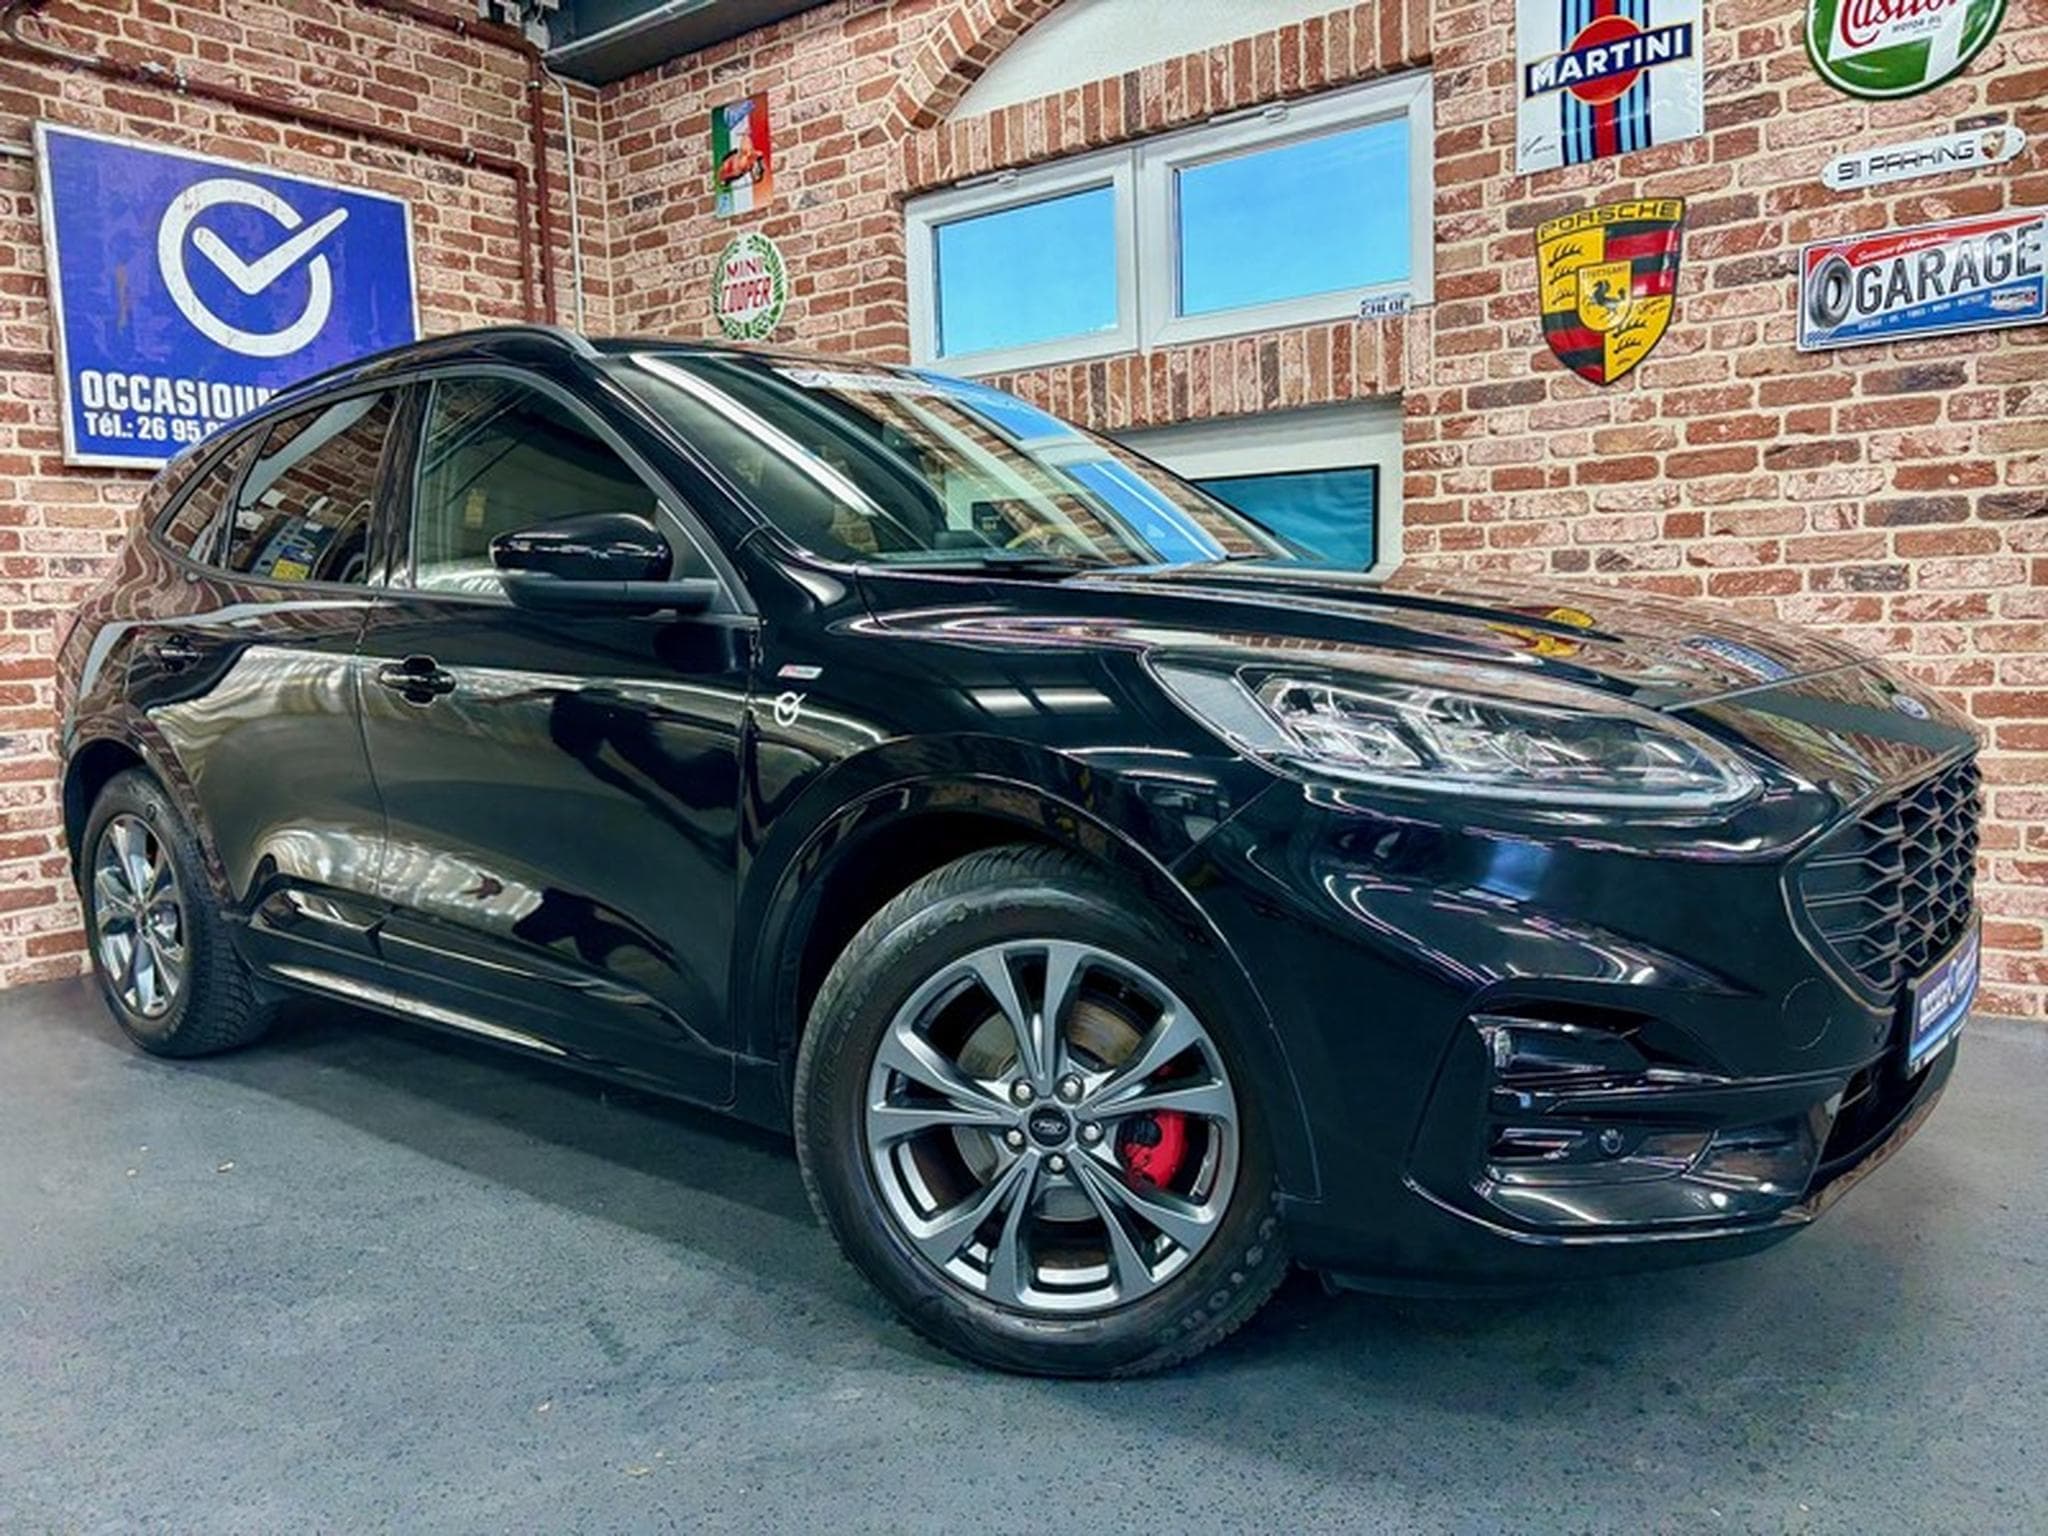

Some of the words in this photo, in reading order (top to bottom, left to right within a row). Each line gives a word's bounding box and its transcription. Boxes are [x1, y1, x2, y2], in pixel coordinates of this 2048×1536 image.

[1531, 28, 1684, 92] MARTINI
[1869, 140, 1975, 176] PARKING
[1541, 201, 1678, 239] PORSCHE
[727, 257, 765, 278] MINI
[1855, 221, 2044, 316] GARAGE
[722, 276, 772, 314] COOPER
[137, 417, 167, 441] 26
[171, 420, 201, 443] 95
